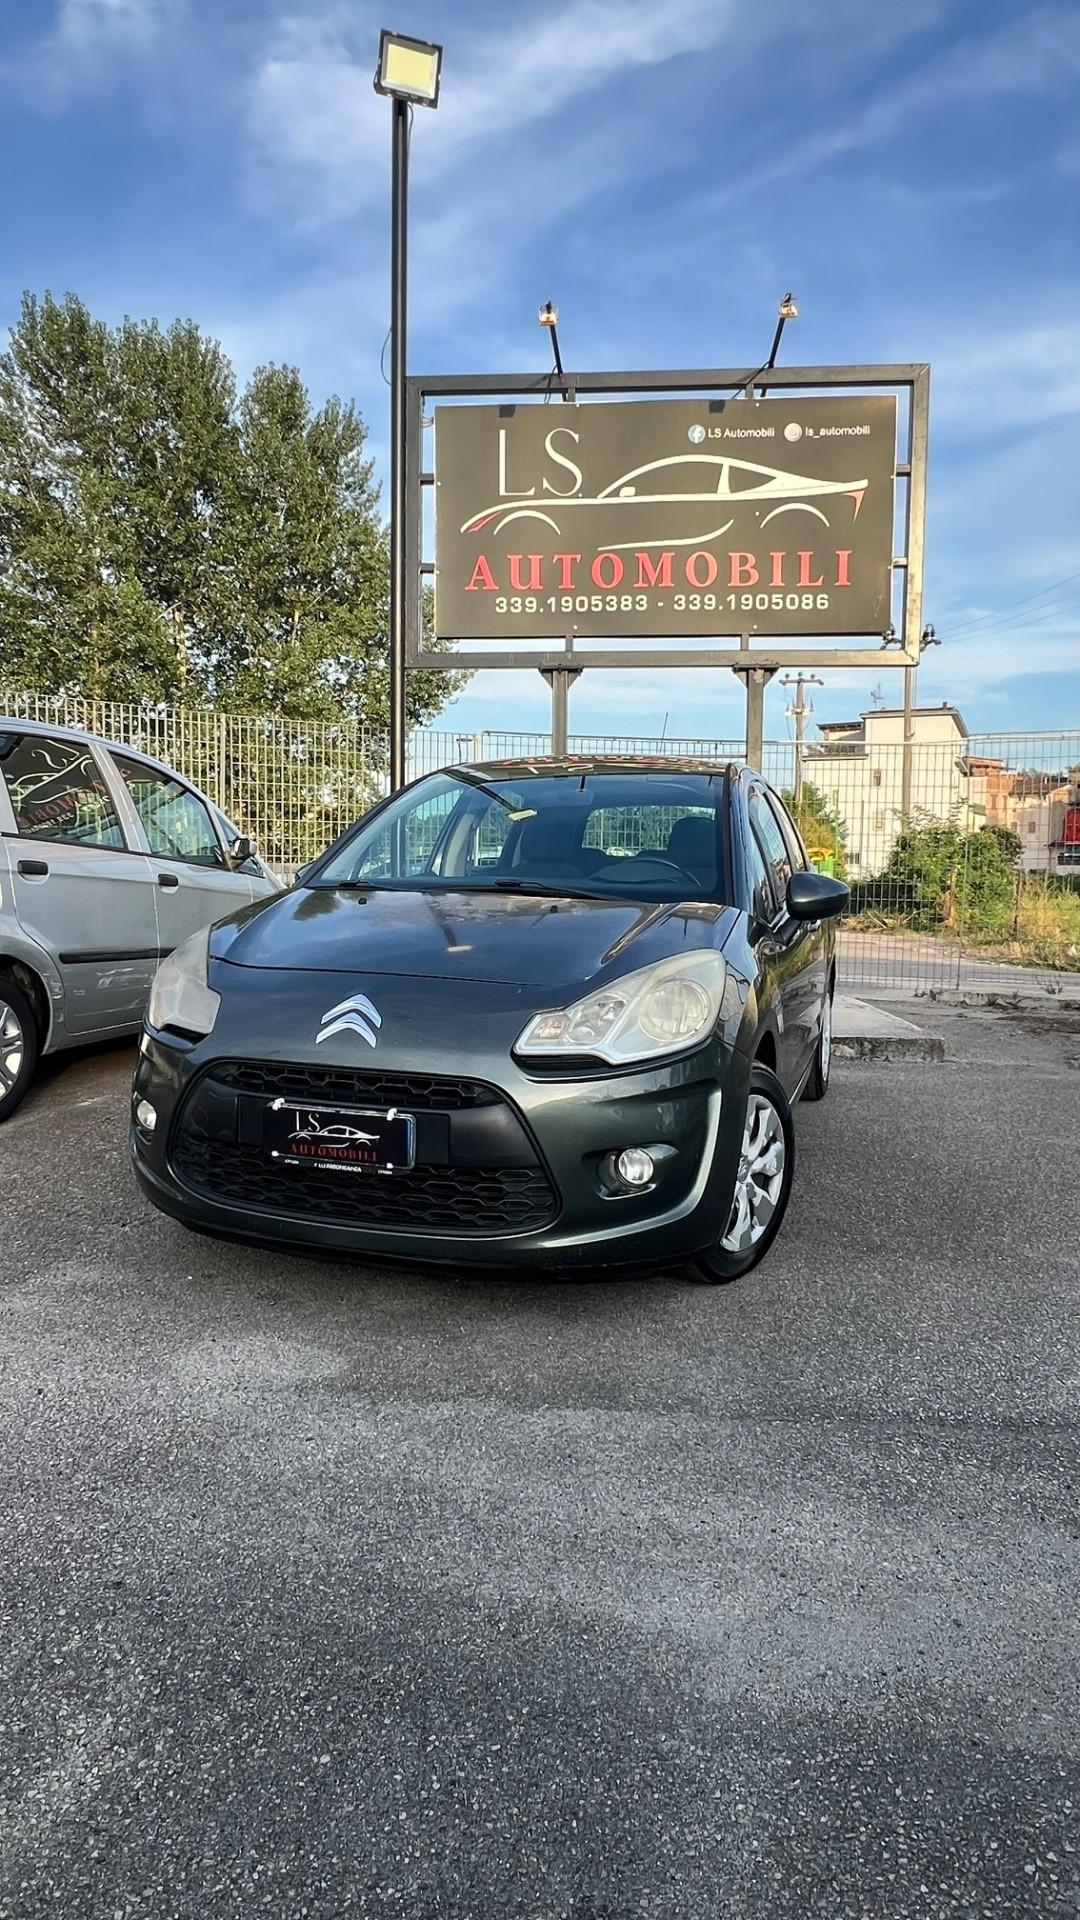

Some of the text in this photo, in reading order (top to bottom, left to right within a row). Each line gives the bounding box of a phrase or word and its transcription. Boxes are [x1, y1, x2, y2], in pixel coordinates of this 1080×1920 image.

[707, 427, 775, 438] LS Automobili
[805, 425, 870, 439] ls_automobili
[499, 427, 583, 497] LS
[464, 550, 852, 591] AUTOMOBILI
[495, 595, 648, 614] 339.1905383
[673, 593, 830, 611] 339.1905086
[289, 1143, 378, 1162] AUTOMOBILI
